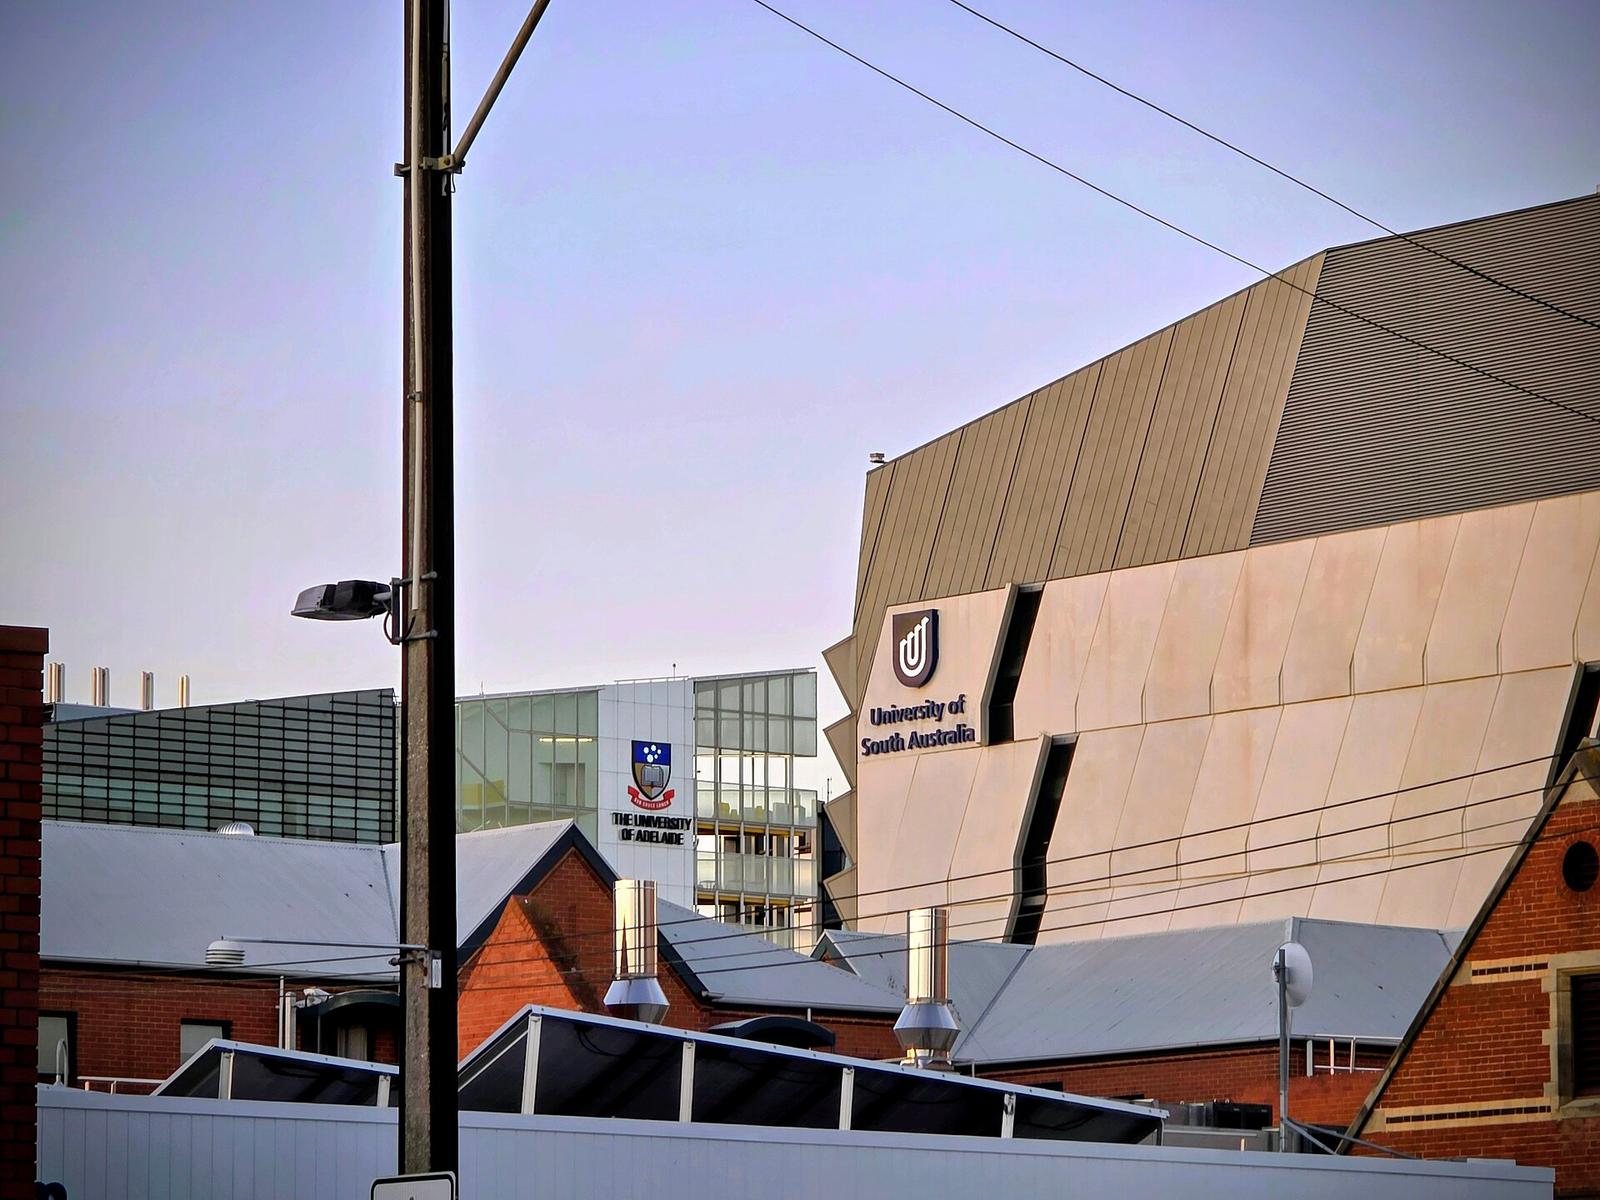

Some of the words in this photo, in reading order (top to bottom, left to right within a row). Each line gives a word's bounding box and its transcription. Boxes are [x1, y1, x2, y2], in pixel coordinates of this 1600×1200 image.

[870, 700, 945, 726] University
[947, 694, 966, 714] of
[861, 732, 905, 756] South
[907, 723, 976, 749] Australia
[612, 812, 633, 826] THE
[634, 814, 692, 830] UNIVERSITY
[621, 828, 634, 841] OF
[636, 829, 684, 845] ADELAIDE
